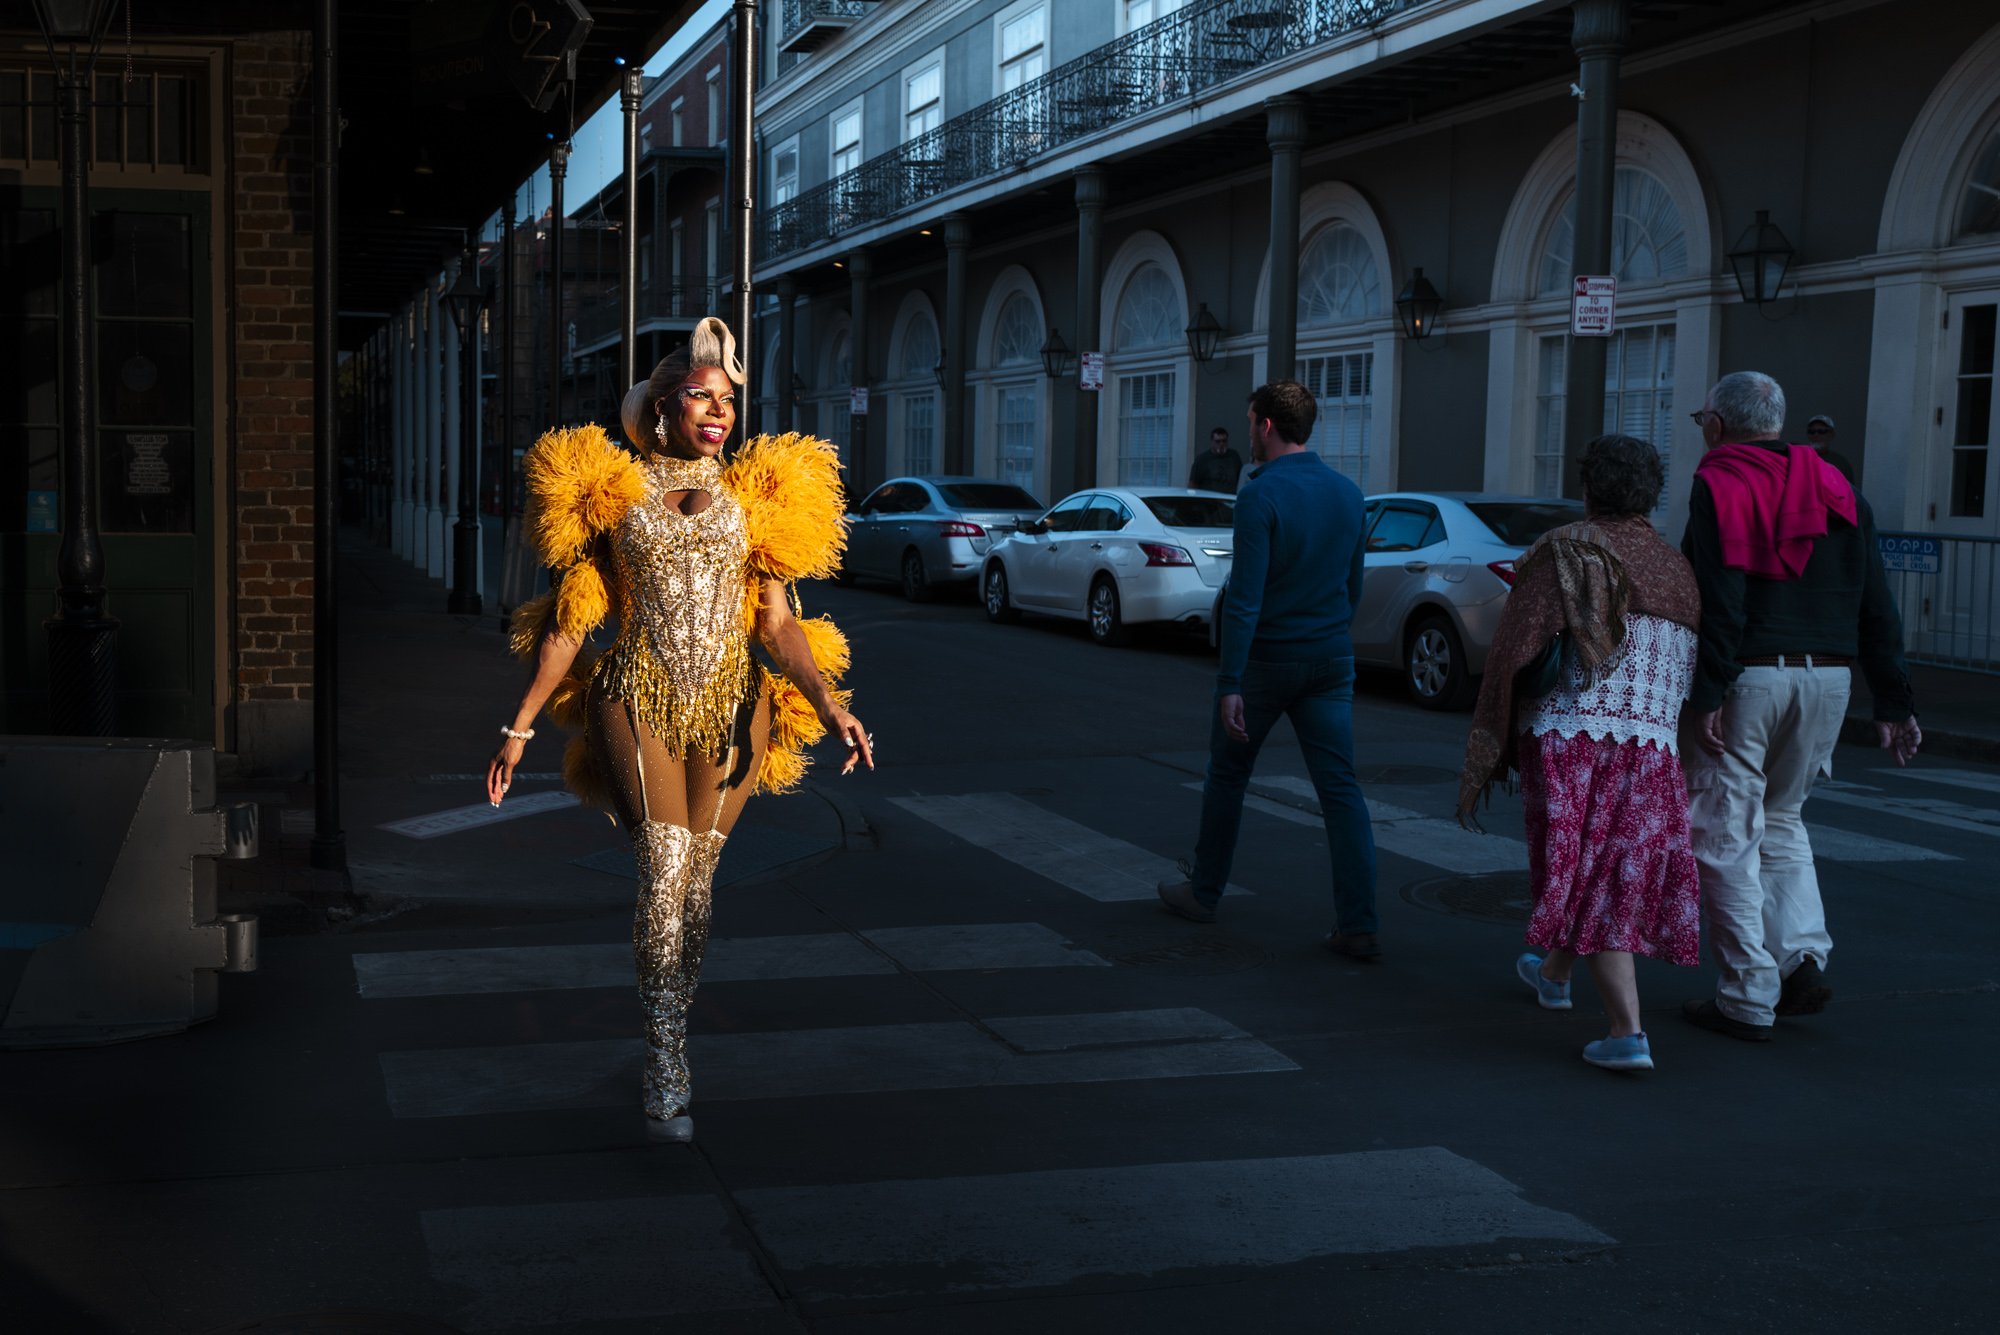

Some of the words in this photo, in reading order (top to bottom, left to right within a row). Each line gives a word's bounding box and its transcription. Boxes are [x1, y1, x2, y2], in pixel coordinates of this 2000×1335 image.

[1576, 281, 1587, 292] NO
[1588, 283, 1614, 291] STOPPING
[1590, 297, 1599, 305] TO
[1579, 306, 1609, 314] CORNER
[1577, 316, 1609, 324] ANYTIME
